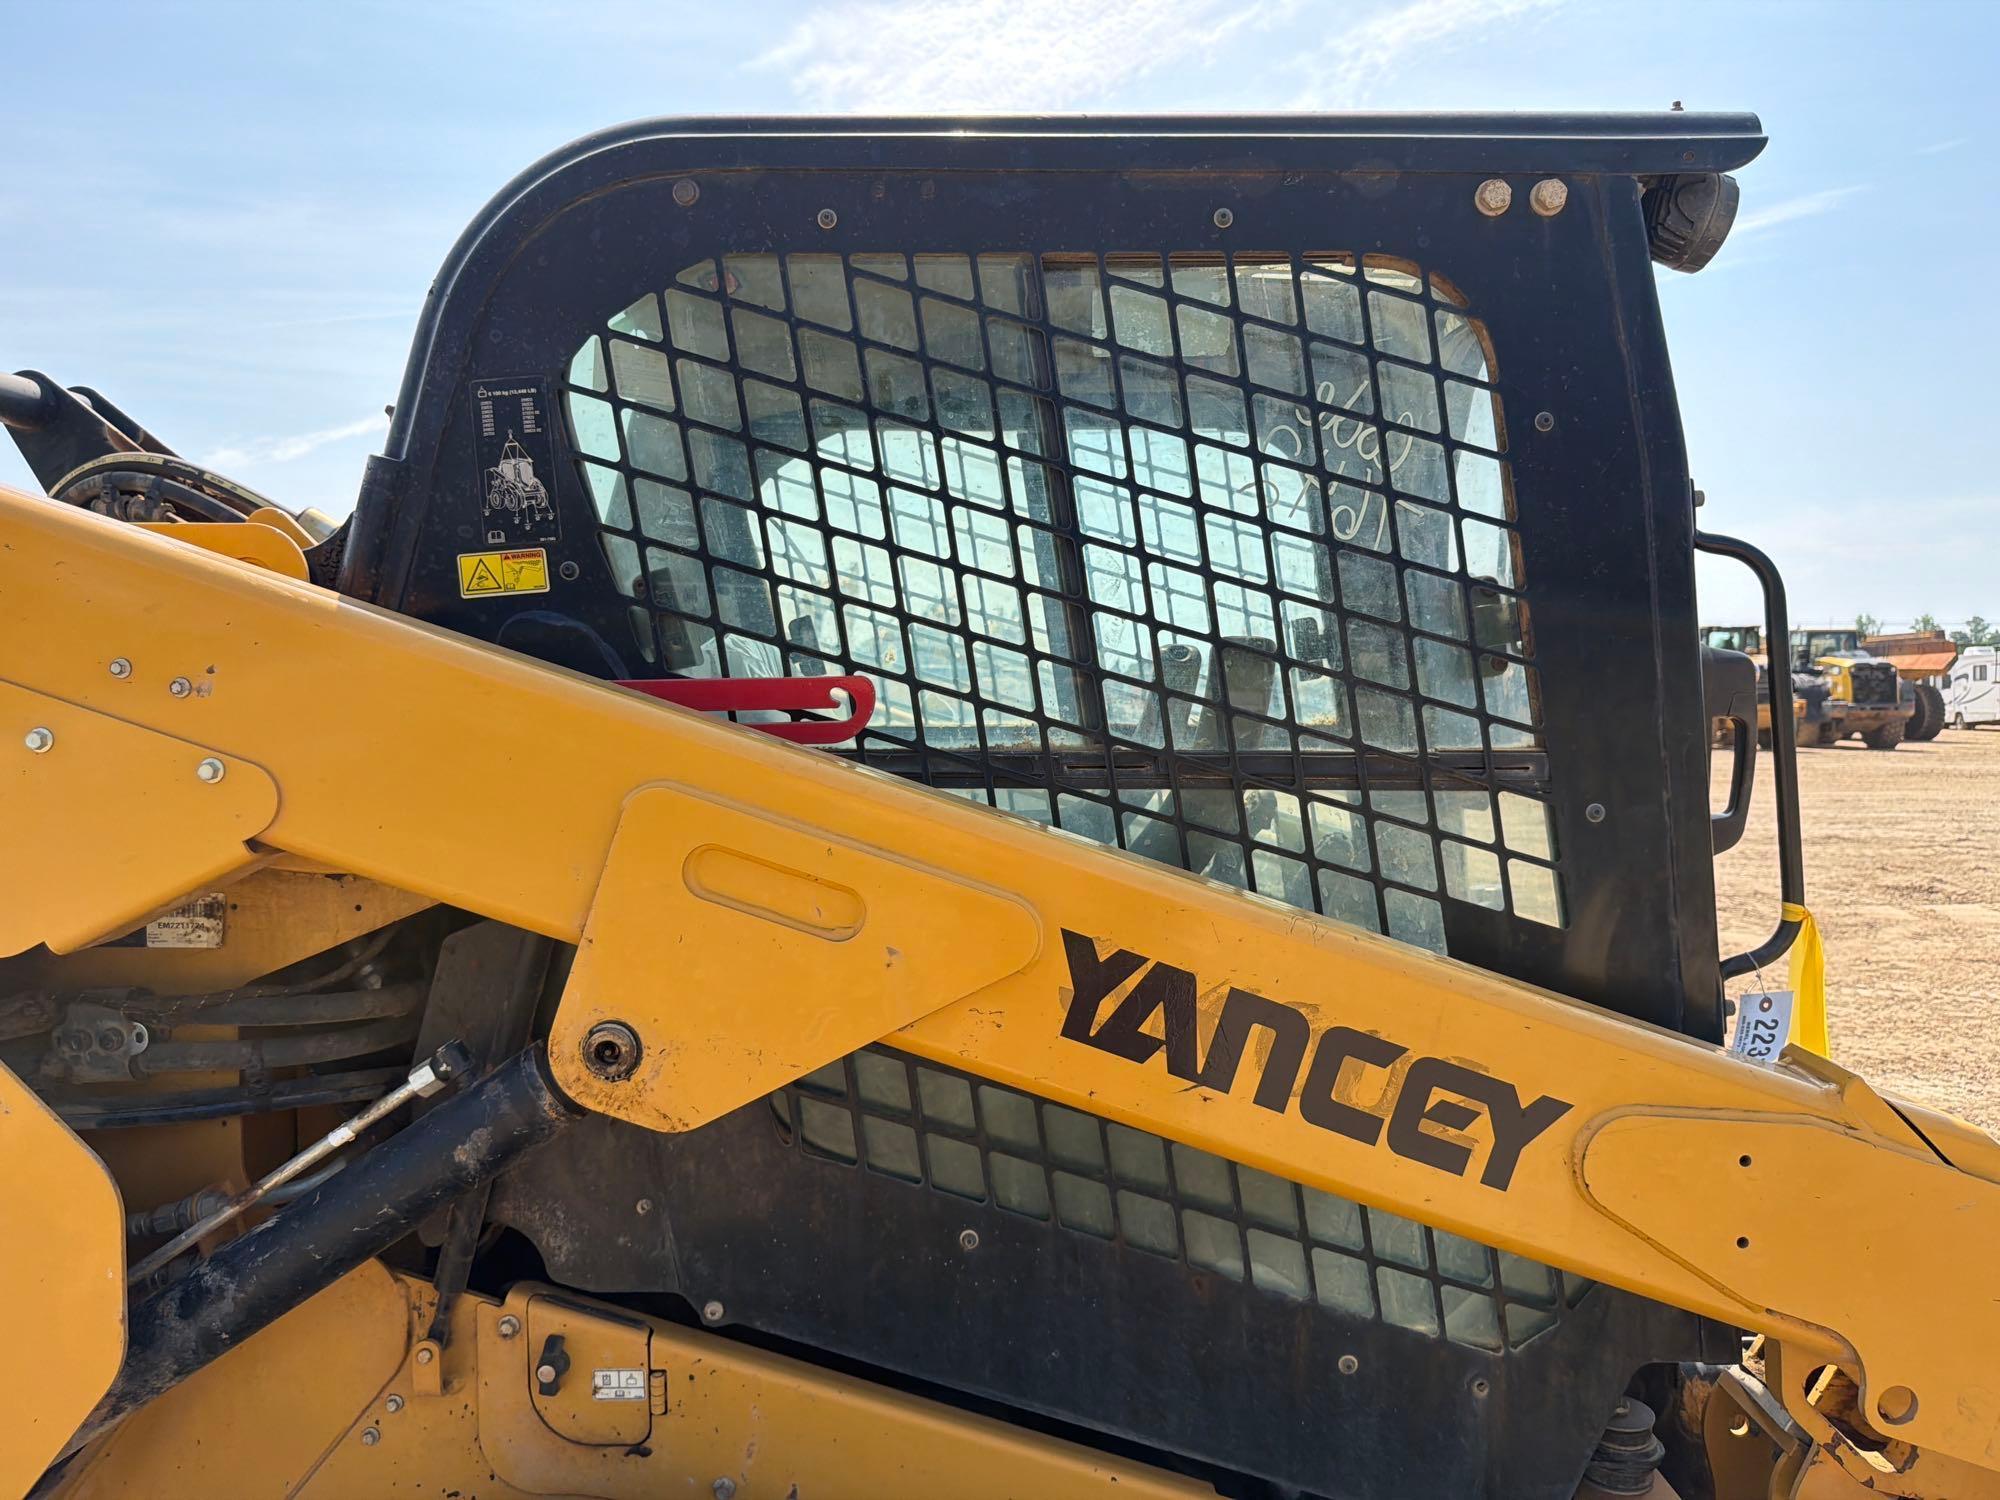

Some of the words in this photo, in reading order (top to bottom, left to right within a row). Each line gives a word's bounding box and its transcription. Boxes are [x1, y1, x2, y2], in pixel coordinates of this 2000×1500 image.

[511, 552, 541, 560] WARNING
[1060, 927, 1574, 1192] YANCEY
[1747, 1018, 1779, 1060] 223
